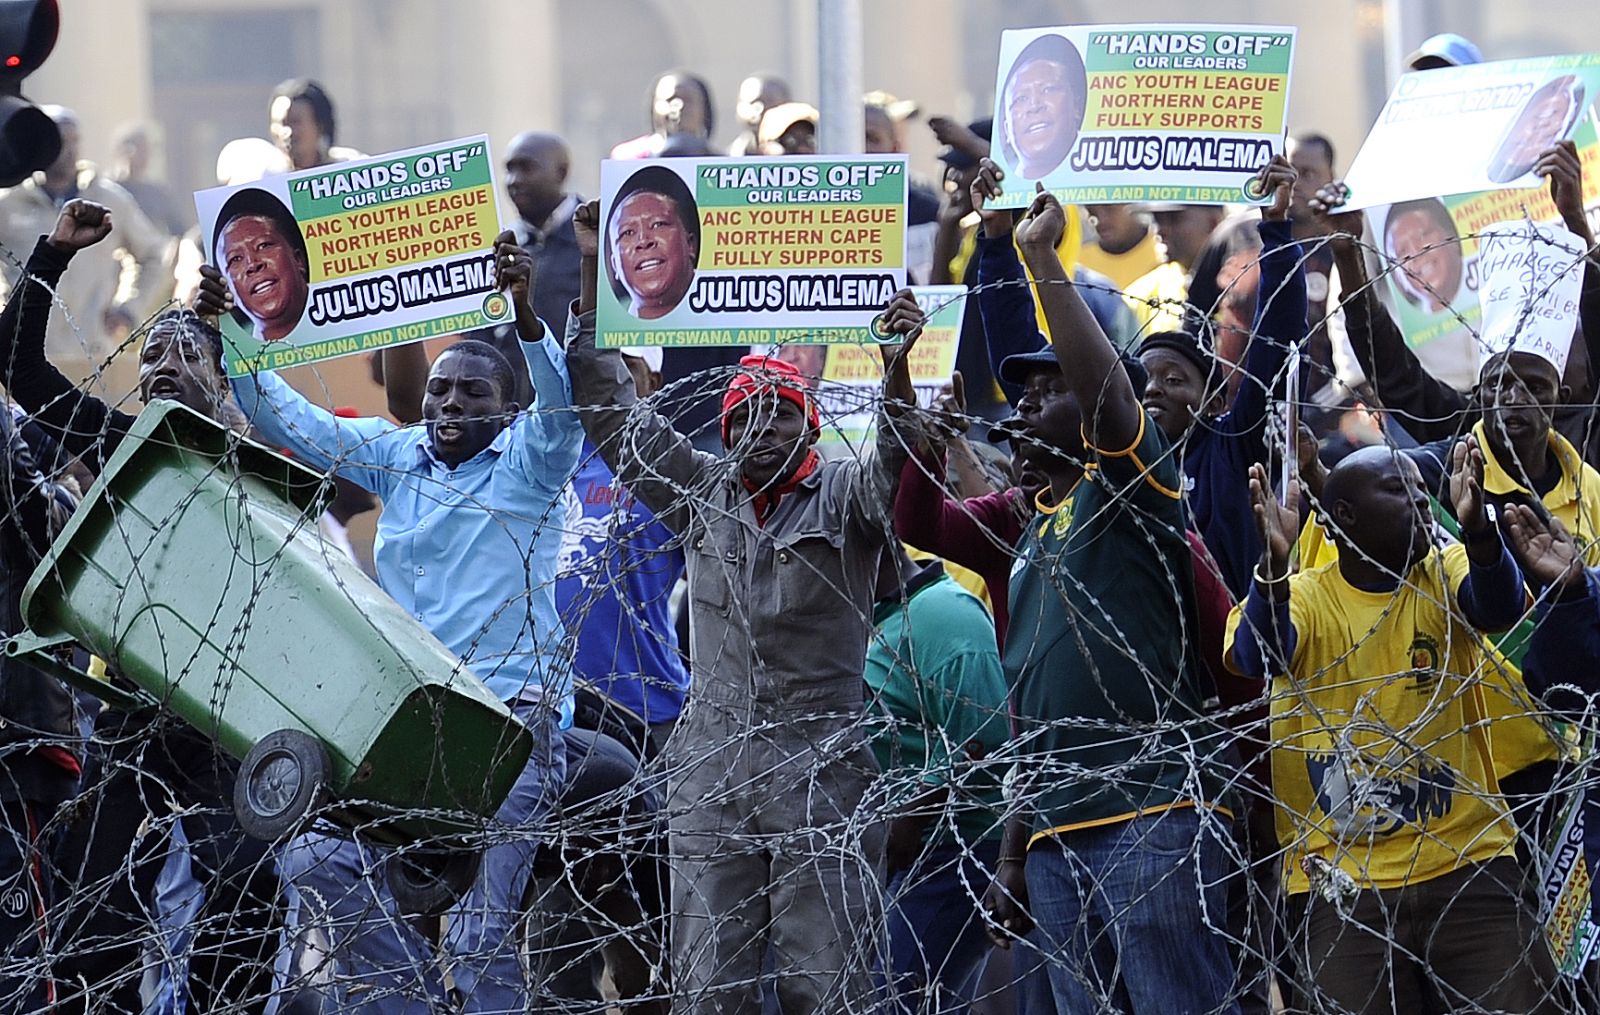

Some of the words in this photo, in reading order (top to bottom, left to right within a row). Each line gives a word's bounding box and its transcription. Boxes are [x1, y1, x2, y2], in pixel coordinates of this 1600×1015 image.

[1133, 55, 1170, 69] OUR
[1173, 57, 1248, 70] LEADERS
[1089, 75, 1128, 89] ANC
[1134, 75, 1198, 90] YOUTH
[1203, 76, 1281, 92] LEAGUE
[1100, 93, 1206, 109] NORTHERN
[1211, 94, 1264, 110] CAPE
[1096, 112, 1154, 127] FULLY
[1159, 113, 1264, 130] SUPPORTS
[1071, 139, 1161, 170] JULIUS
[1164, 141, 1272, 172] MALEMA
[342, 191, 378, 210] OUR
[381, 177, 453, 202] LEADERS
[746, 190, 783, 204] OUR
[786, 189, 863, 203] LEADERS
[1027, 187, 1108, 204] BSWANA
[1111, 187, 1144, 201] AND
[1148, 187, 1182, 201] NOT
[1187, 186, 1240, 202] LIBYA?
[304, 218, 343, 240] ANC
[346, 206, 410, 232] YOUTH
[415, 189, 489, 218] LEAGUE
[702, 211, 742, 226] ANC
[748, 209, 814, 225] YOUTH
[819, 208, 897, 224] LEAGUE
[1455, 201, 1484, 221] ANC
[320, 225, 425, 257] NORTHERN
[428, 211, 479, 235] CAPE
[716, 229, 824, 246] NORTHERN
[830, 228, 882, 244] CAPE
[322, 254, 379, 277] FULLY
[385, 231, 484, 265] SUPPORTS
[713, 250, 773, 266] FULLY
[778, 248, 884, 266] SUPPORTS
[308, 280, 397, 323] JULIUS
[690, 278, 783, 311] JULIUS
[787, 277, 899, 308] MALEMA
[233, 354, 270, 374] WHY
[273, 336, 360, 365] BOTSWANA
[360, 331, 394, 349] AND
[396, 324, 429, 341] NOT
[431, 312, 482, 334] LIBYA?
[603, 331, 640, 346] WHY
[643, 330, 733, 346] BOTSWANA
[736, 329, 771, 345] AND
[774, 328, 809, 344] NOT
[811, 327, 869, 343] LIBYA?
